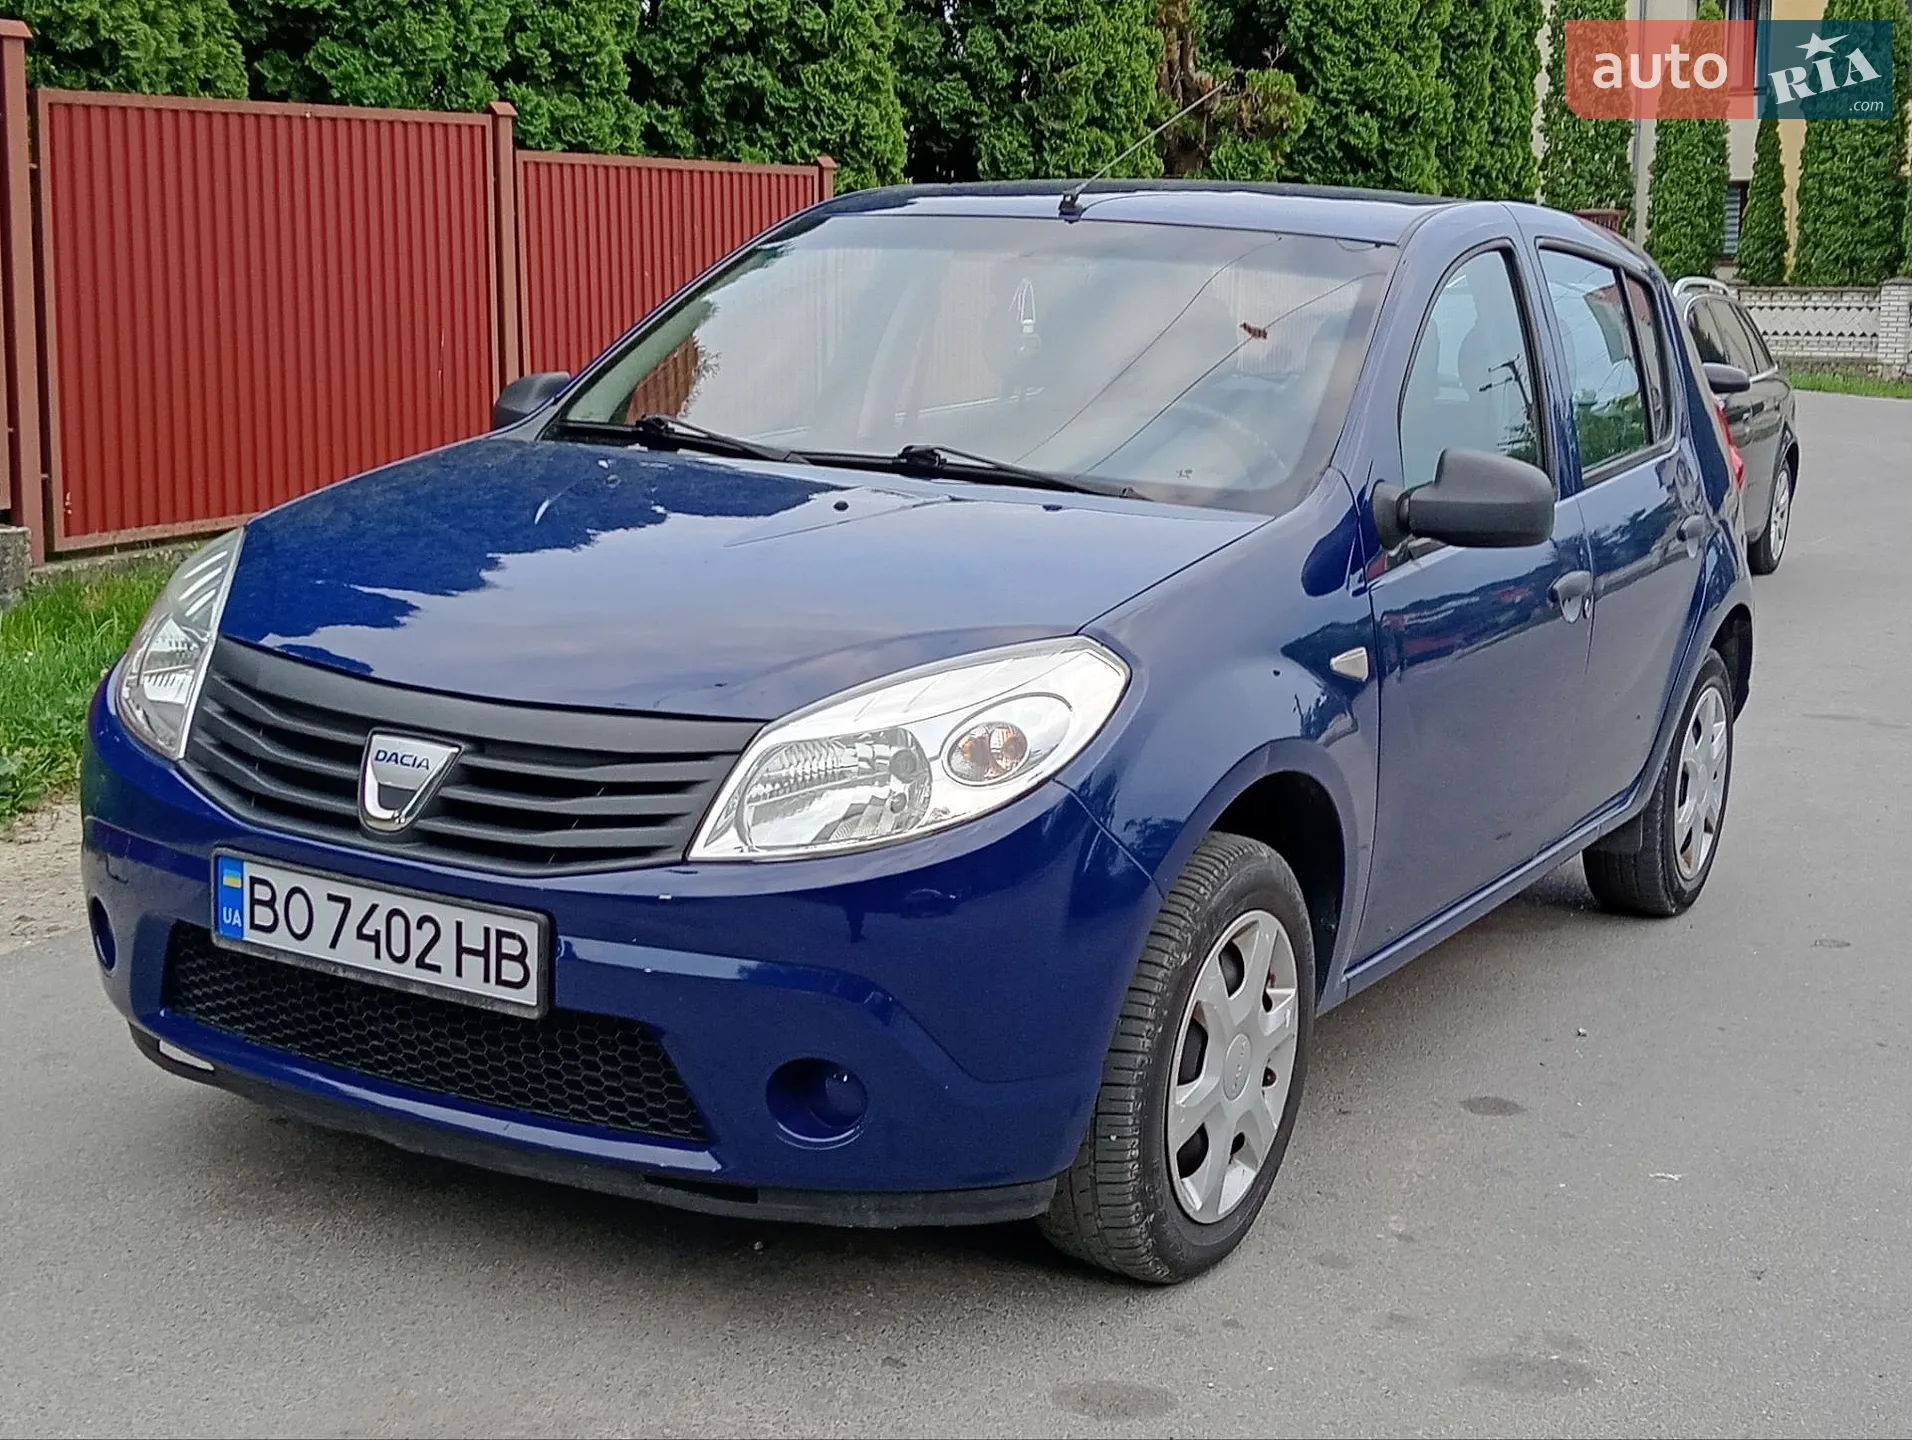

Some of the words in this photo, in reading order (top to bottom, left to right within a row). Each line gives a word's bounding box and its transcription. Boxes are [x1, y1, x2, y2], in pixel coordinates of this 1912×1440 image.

[374, 749, 430, 771] DACIA
[222, 906, 242, 928] UA
[326, 892, 442, 974] 7402
